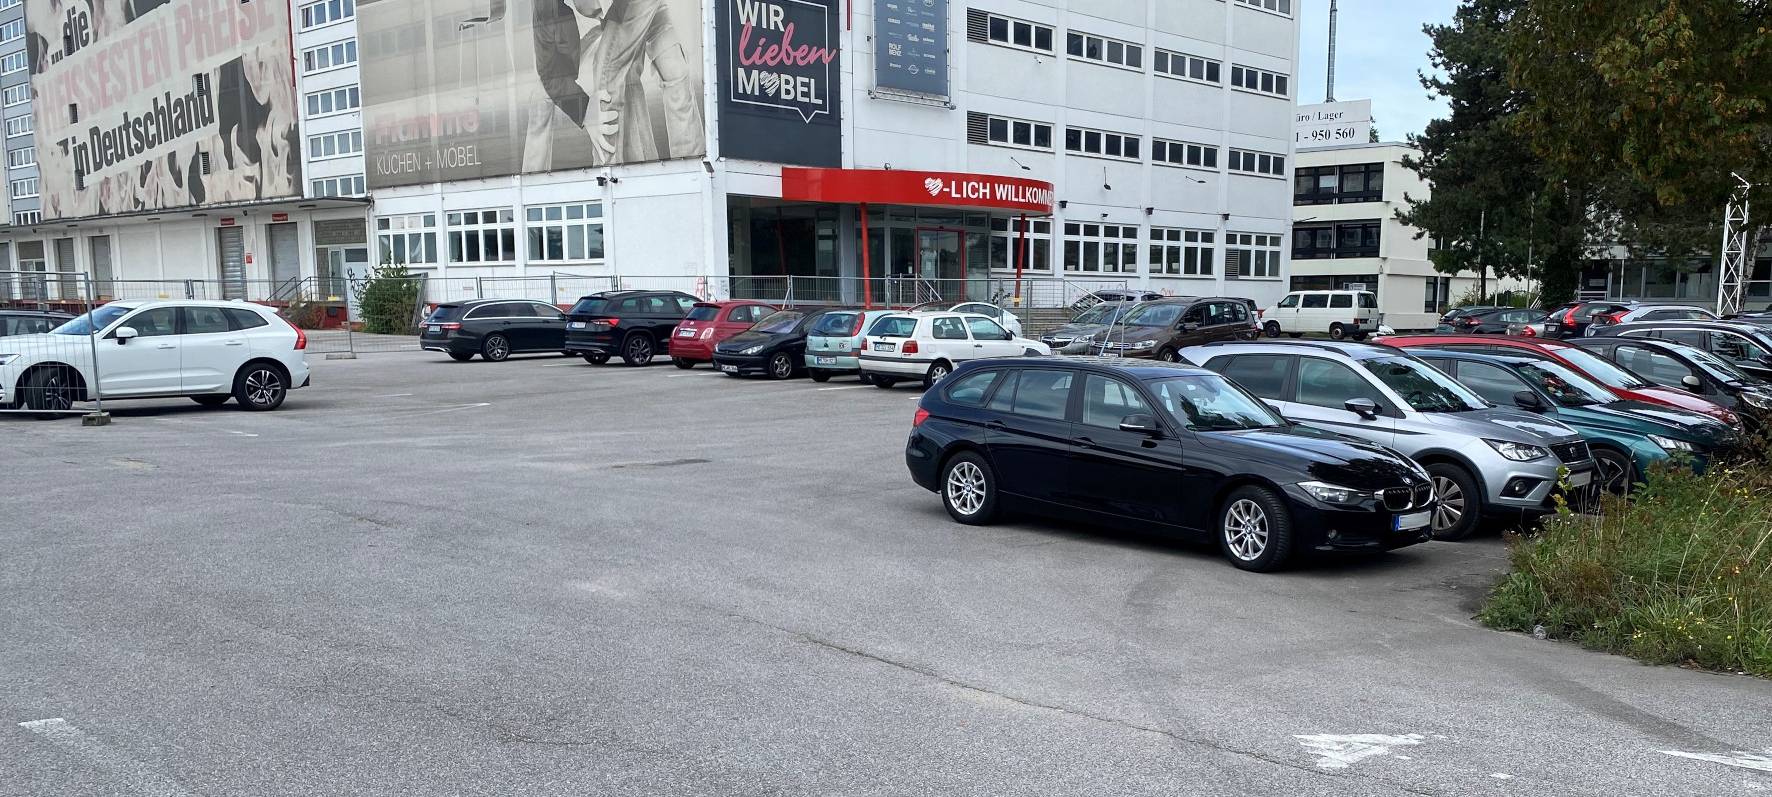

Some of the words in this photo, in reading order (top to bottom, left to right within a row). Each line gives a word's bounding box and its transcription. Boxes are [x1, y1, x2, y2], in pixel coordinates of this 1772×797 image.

[736, 0, 785, 31] WIR
[175, 0, 276, 70] PREISE
[739, 21, 837, 66] lieben
[71, 135, 91, 177] in
[89, 73, 215, 172] Deutschland
[1318, 111, 1344, 121] Lager
[1312, 129, 1331, 141] 950
[1335, 127, 1355, 140] 560
[376, 150, 421, 175] KÜCHEN
[425, 157, 432, 171] +
[436, 141, 482, 168] MÖBEL
